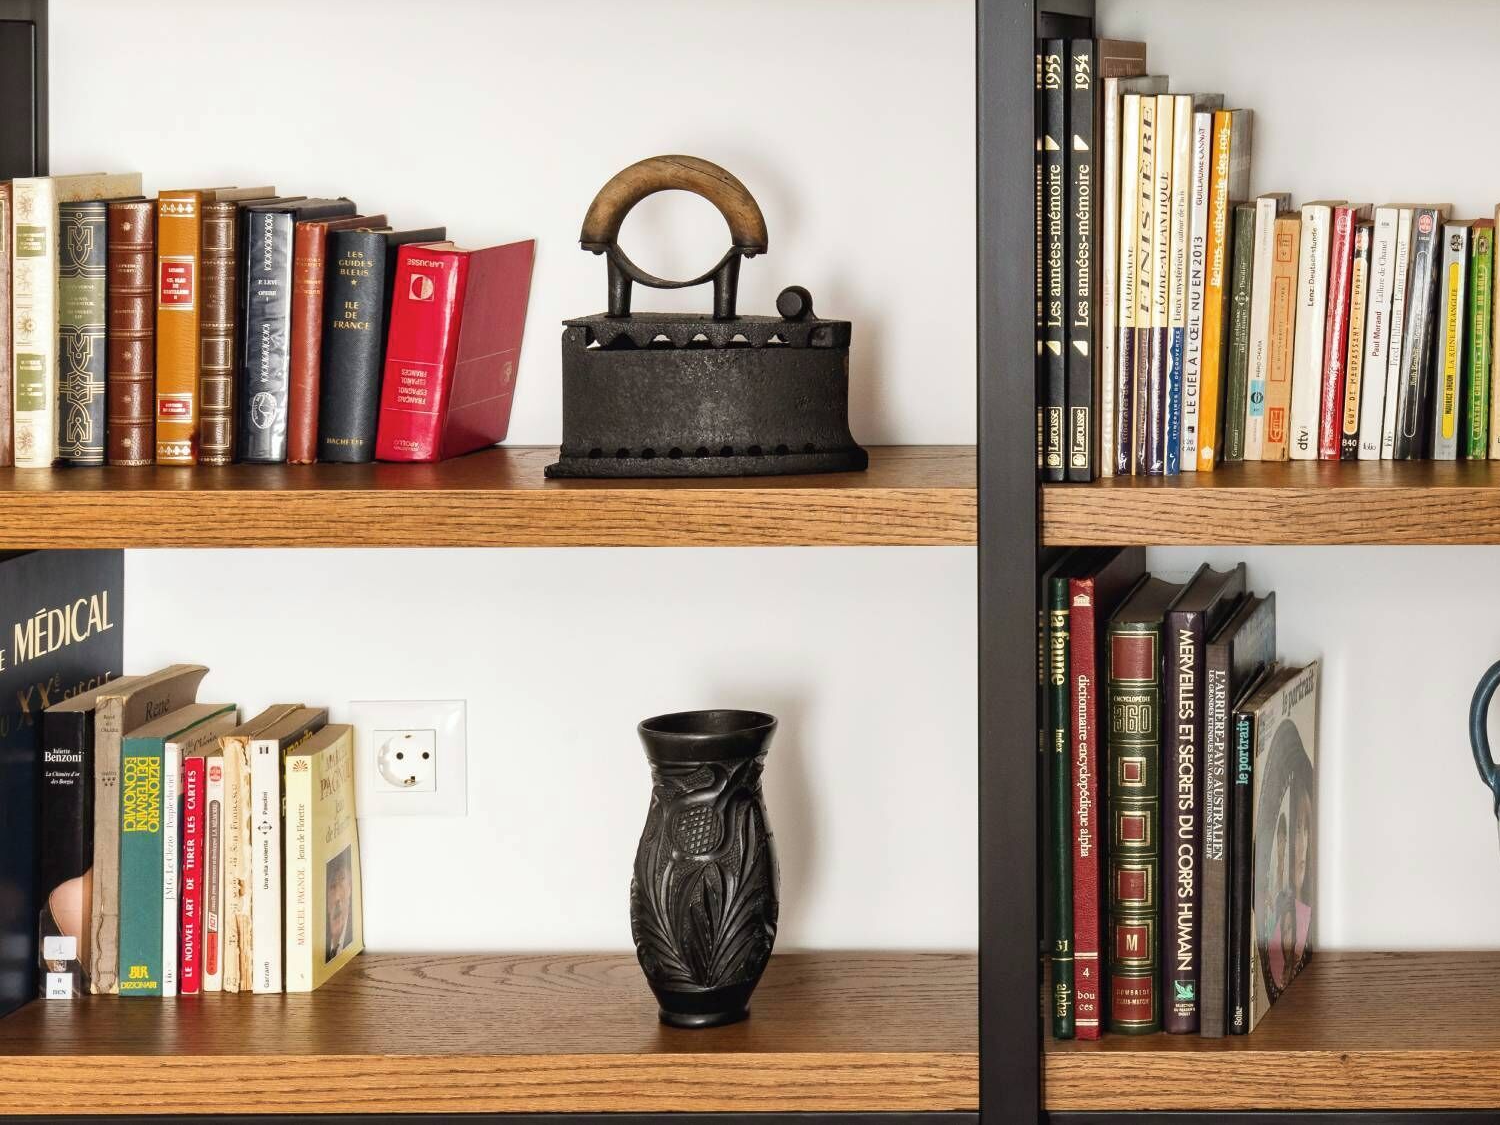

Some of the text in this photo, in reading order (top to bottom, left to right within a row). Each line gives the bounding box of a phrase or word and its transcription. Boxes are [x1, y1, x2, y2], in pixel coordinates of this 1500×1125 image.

[1046, 54, 1060, 90] 1955
[1074, 54, 1089, 90] 1954
[1137, 106, 1152, 312] FINISTÈRE
[1047, 165, 1061, 327] Les années-mémoire
[1075, 165, 1090, 327] Les années-mémoire
[1192, 236, 1203, 265] 2013
[340, 268, 369, 276] BLEUS
[1192, 268, 1201, 287] EN
[345, 301, 359, 309] ILE
[1191, 291, 1200, 310] NU
[334, 321, 370, 330] FRANCE
[1187, 369, 1198, 396] CIEL
[1187, 399, 1196, 414] LE
[1048, 409, 1060, 451] Larousse
[1075, 409, 1086, 451] Larousse
[14, 590, 114, 664] MÉDICAL
[1051, 610, 1068, 685] la faune
[44, 751, 81, 763] Benzoni
[1056, 729, 1064, 752] Index
[1237, 721, 1250, 784] le portrait
[1077, 675, 1093, 856] dictionnaire encyclopédique alpha
[124, 757, 136, 831] ECONOMICI
[136, 757, 148, 831] DEI TERMINI
[148, 757, 160, 832] DIZIONARIO
[187, 770, 196, 809] CARTES
[1177, 629, 1195, 970] MERVEILLES ET SECRETS DU CORPS HUMAIN
[187, 816, 195, 833] LES
[297, 804, 306, 859] Jean de Florette
[1212, 780, 1224, 861] AUSTRALIEN
[187, 840, 195, 869] TIRER
[186, 878, 194, 889] DE
[185, 924, 193, 961] NOUVEL
[185, 967, 193, 977] LE
[1054, 984, 1070, 1017] alpha
[1234, 1006, 1243, 1026] Solar
